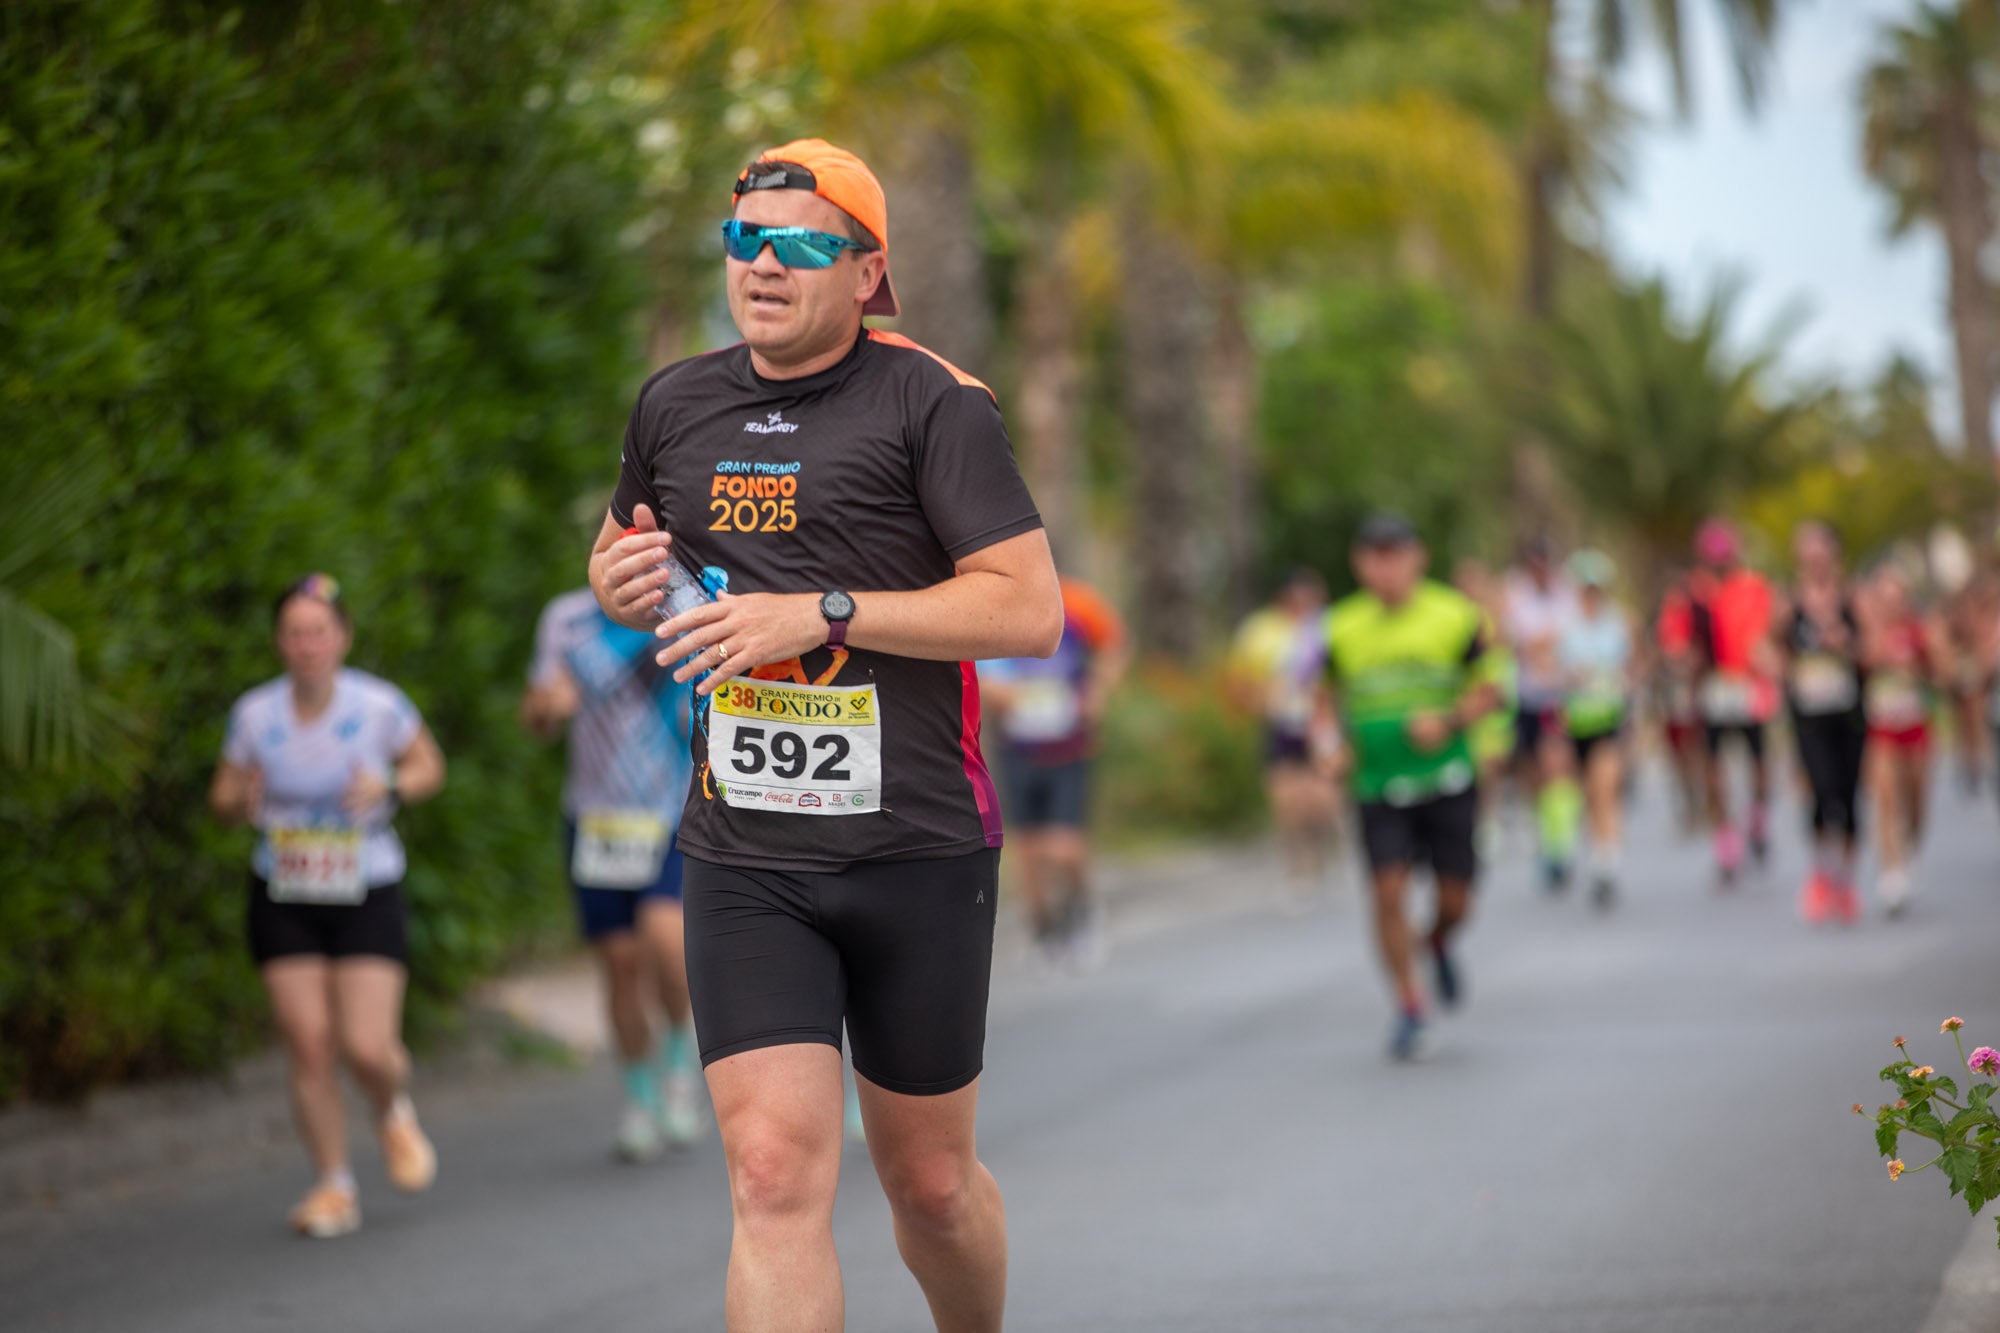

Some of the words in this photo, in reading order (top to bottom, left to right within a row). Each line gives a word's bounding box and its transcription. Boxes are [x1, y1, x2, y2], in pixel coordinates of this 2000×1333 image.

[716, 461, 752, 474] GRAN
[754, 461, 801, 475] PREMIO
[711, 476, 798, 498] FONDO
[709, 499, 798, 532] 2025
[731, 685, 756, 709] 38
[760, 688, 790, 700] GRAN
[792, 692, 833, 703] PREMIO
[755, 696, 841, 719] FONDO
[730, 726, 851, 781] 592
[728, 786, 762, 798] Cruzcampo
